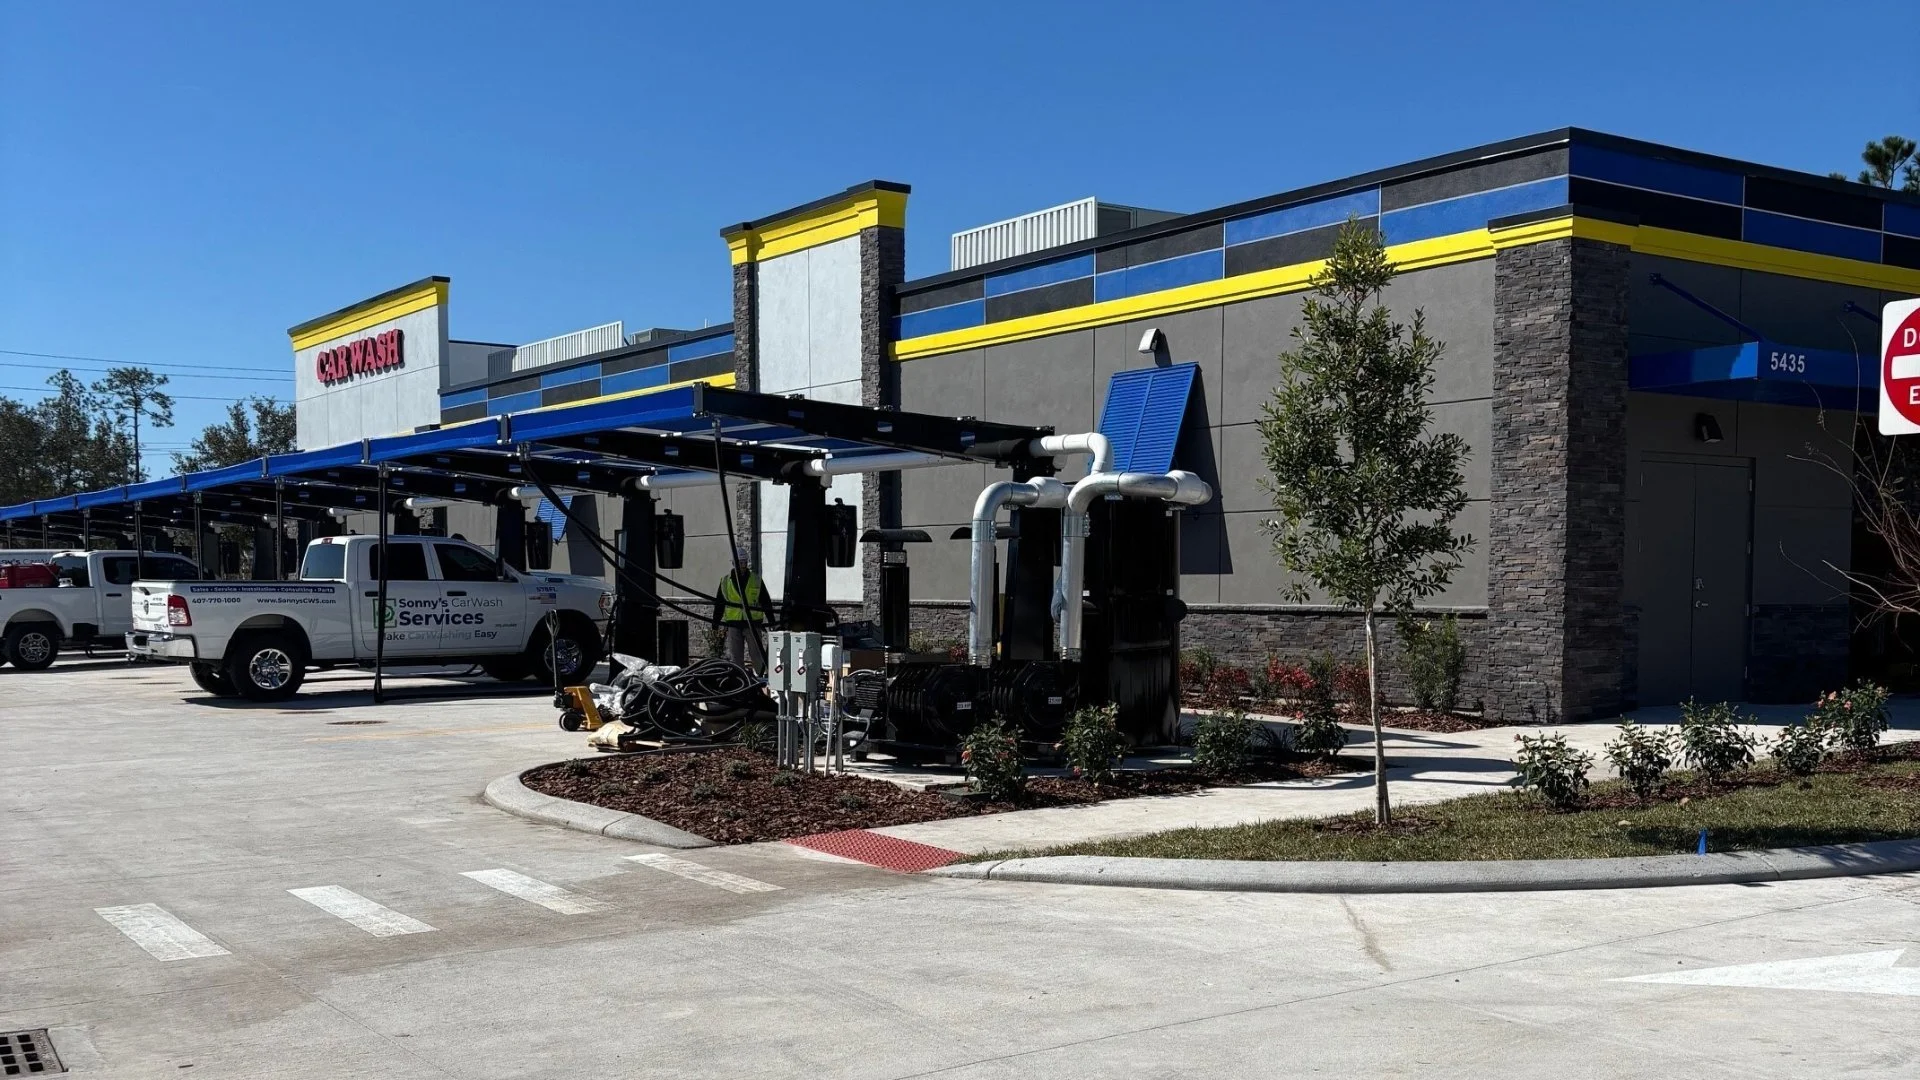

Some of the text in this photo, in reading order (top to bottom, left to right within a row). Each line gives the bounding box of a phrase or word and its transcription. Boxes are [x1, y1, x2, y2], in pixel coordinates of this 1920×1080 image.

[1904, 327, 1920, 348] D
[315, 328, 404, 384] CAR WASH
[1771, 352, 1805, 373] 5435
[399, 597, 503, 609] Sonny's CarWash
[399, 609, 484, 626] Services
[384, 630, 497, 640] ake CarWashing Easy
